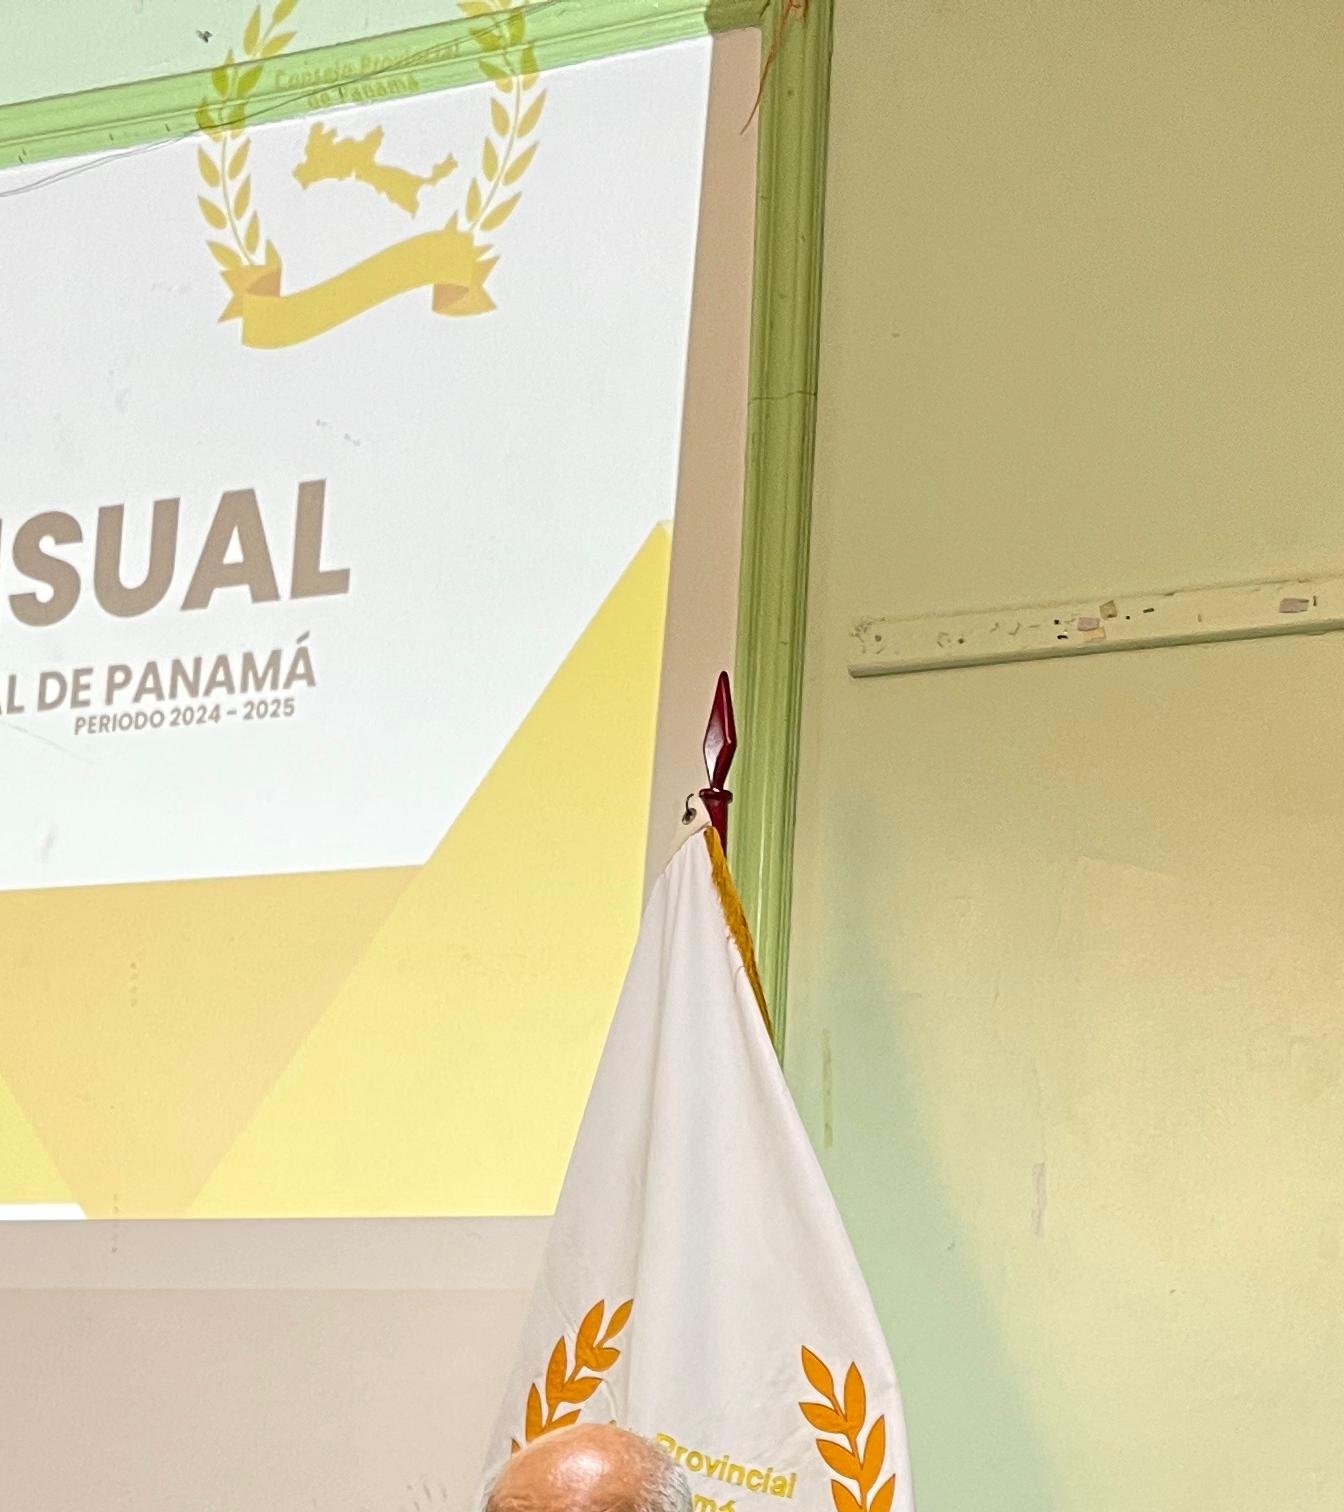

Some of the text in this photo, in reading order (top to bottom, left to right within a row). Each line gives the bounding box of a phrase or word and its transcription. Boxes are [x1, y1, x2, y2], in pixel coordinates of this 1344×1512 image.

[37, 667, 93, 712] DE
[104, 631, 317, 706] PANAMÁ
[74, 710, 165, 735] PERIODO
[169, 706, 220, 728] 2024
[242, 699, 295, 720] 2025
